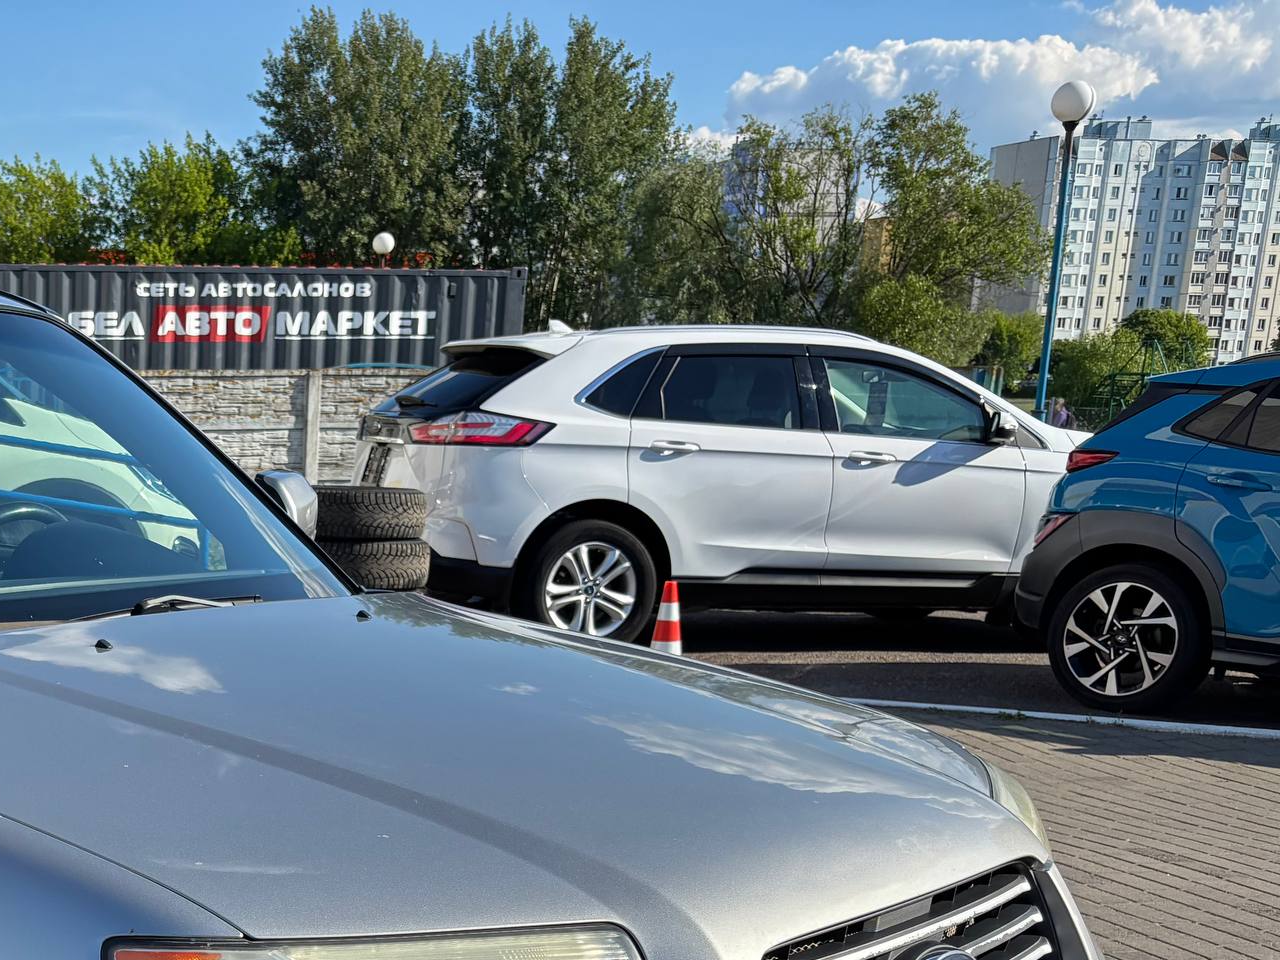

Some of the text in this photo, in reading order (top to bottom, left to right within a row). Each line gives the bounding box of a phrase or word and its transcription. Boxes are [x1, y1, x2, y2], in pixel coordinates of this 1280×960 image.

[136, 282, 372, 298] СЕТЬ АВТОСАЛОНОВ
[67, 311, 437, 336] БЕЛ АВТО МАРКЕТ
